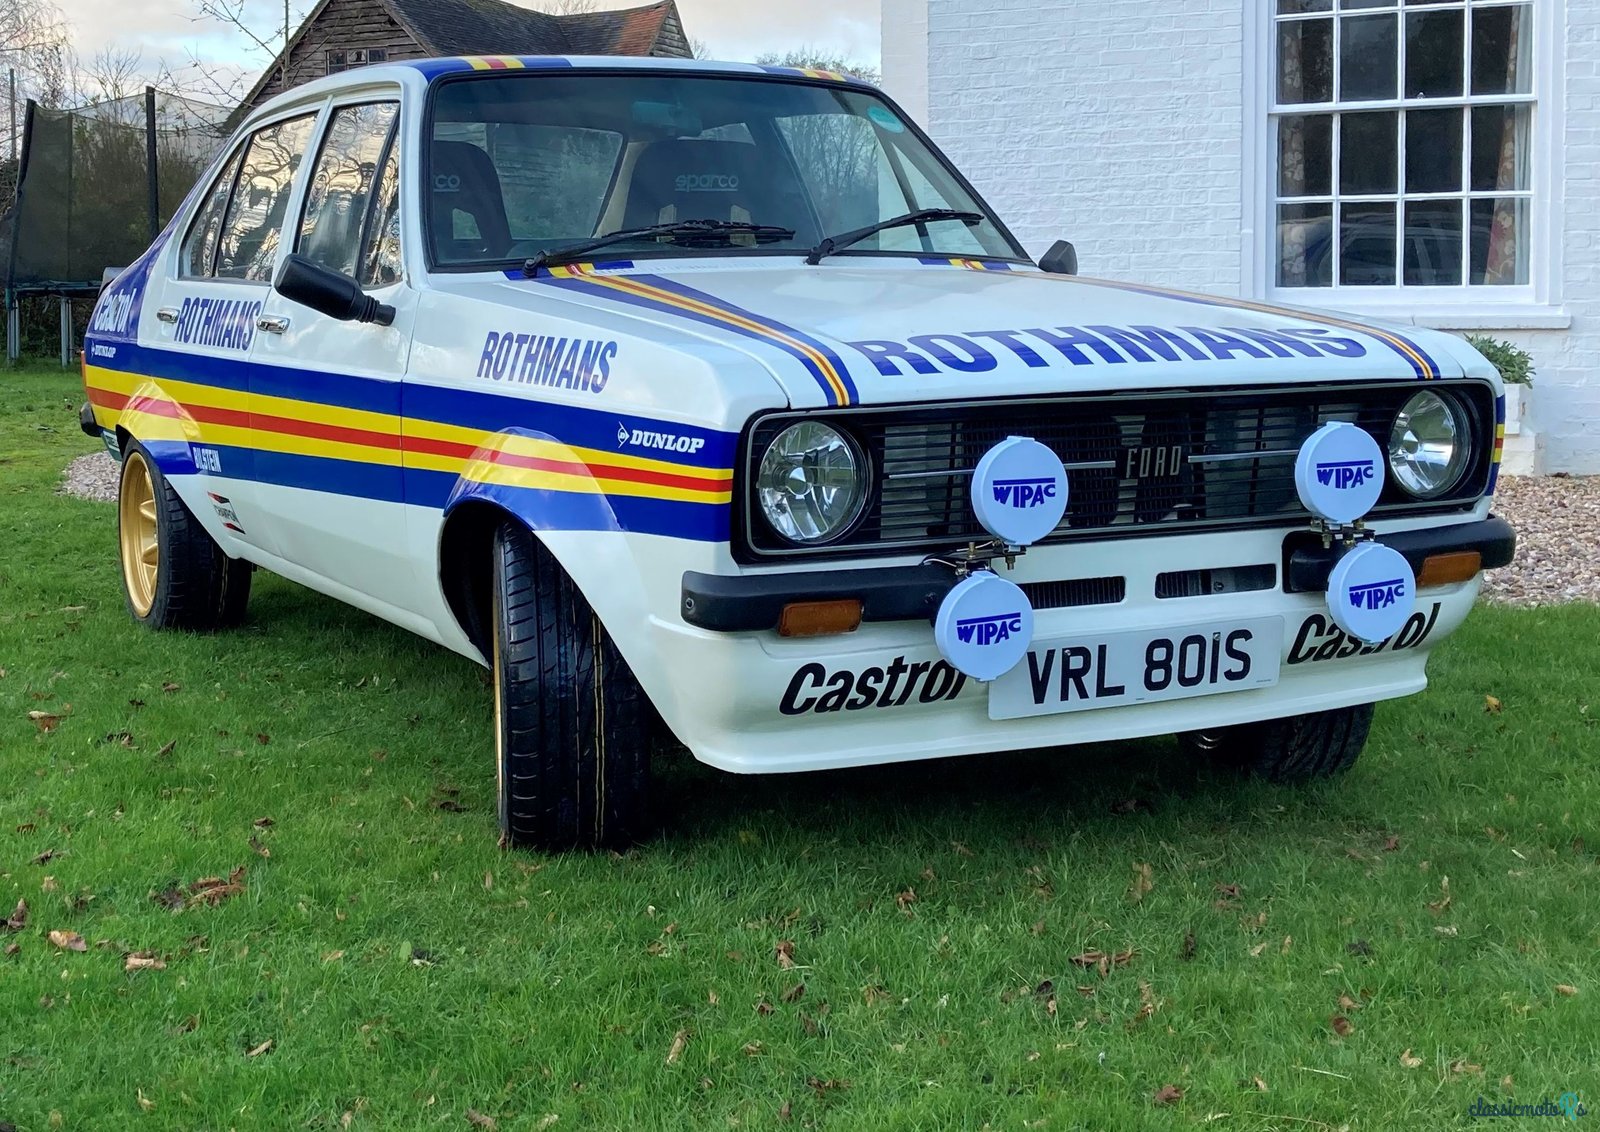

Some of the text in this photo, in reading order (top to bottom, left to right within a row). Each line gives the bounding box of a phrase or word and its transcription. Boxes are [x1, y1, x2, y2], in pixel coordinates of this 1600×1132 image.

[675, 174, 739, 192] sparco
[94, 288, 137, 332] Castrol
[174, 297, 261, 351] ROTHMANS
[476, 331, 618, 394] ROTHMANS
[844, 324, 1368, 377] ROTHMANS
[629, 429, 705, 454] DUNLOP
[1125, 446, 1181, 478] FORD
[1316, 466, 1374, 489] WIPAC
[993, 483, 1056, 508] WIPAC
[1349, 584, 1405, 610] WIPAC
[956, 618, 1021, 646] WIPAC
[1286, 601, 1442, 665] Casol
[1027, 629, 1254, 705] VRL 801S
